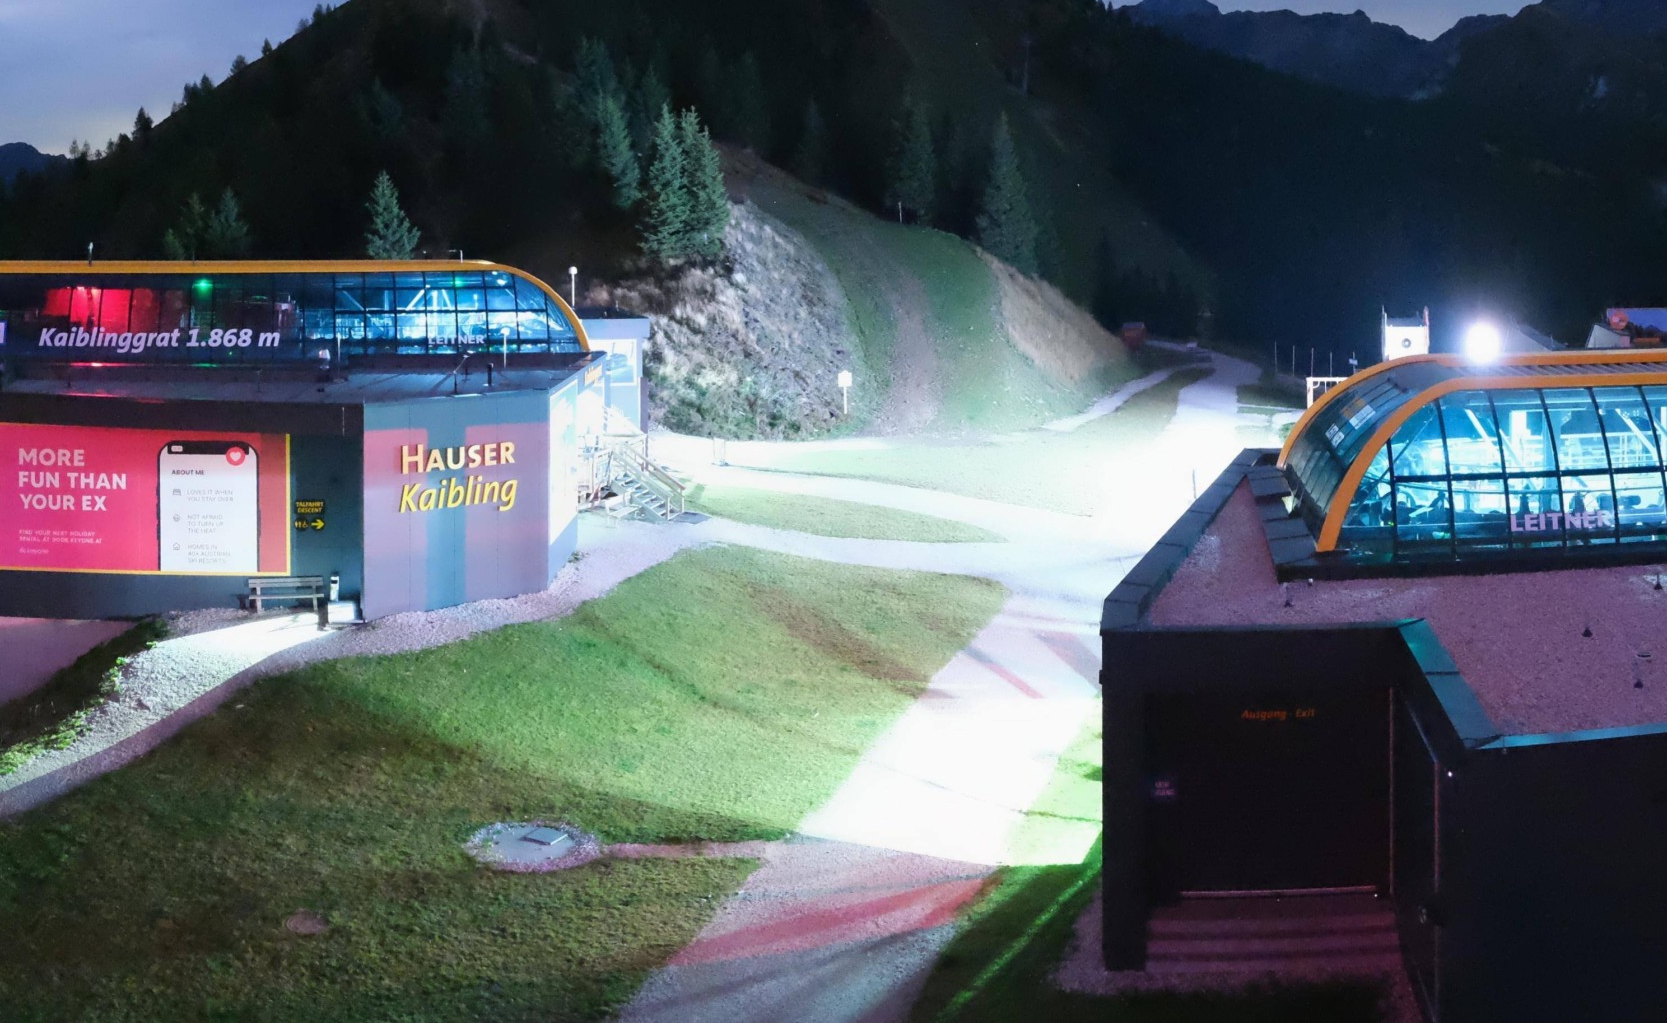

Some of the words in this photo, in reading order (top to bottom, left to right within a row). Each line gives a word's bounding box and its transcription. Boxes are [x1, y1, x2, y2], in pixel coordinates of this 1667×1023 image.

[38, 326, 179, 353] Kaiblinggrat
[185, 327, 252, 348] 1.868
[258, 332, 280, 347] m
[427, 334, 485, 345] LEITNER
[18, 448, 85, 467] MORE
[400, 441, 516, 475] HAUSER
[18, 471, 60, 488] FUN
[66, 472, 127, 490] THAN
[19, 493, 75, 510] YOUR
[81, 495, 107, 512] EX
[398, 476, 519, 514] Kaibling
[1510, 509, 1614, 532] LEITNER
